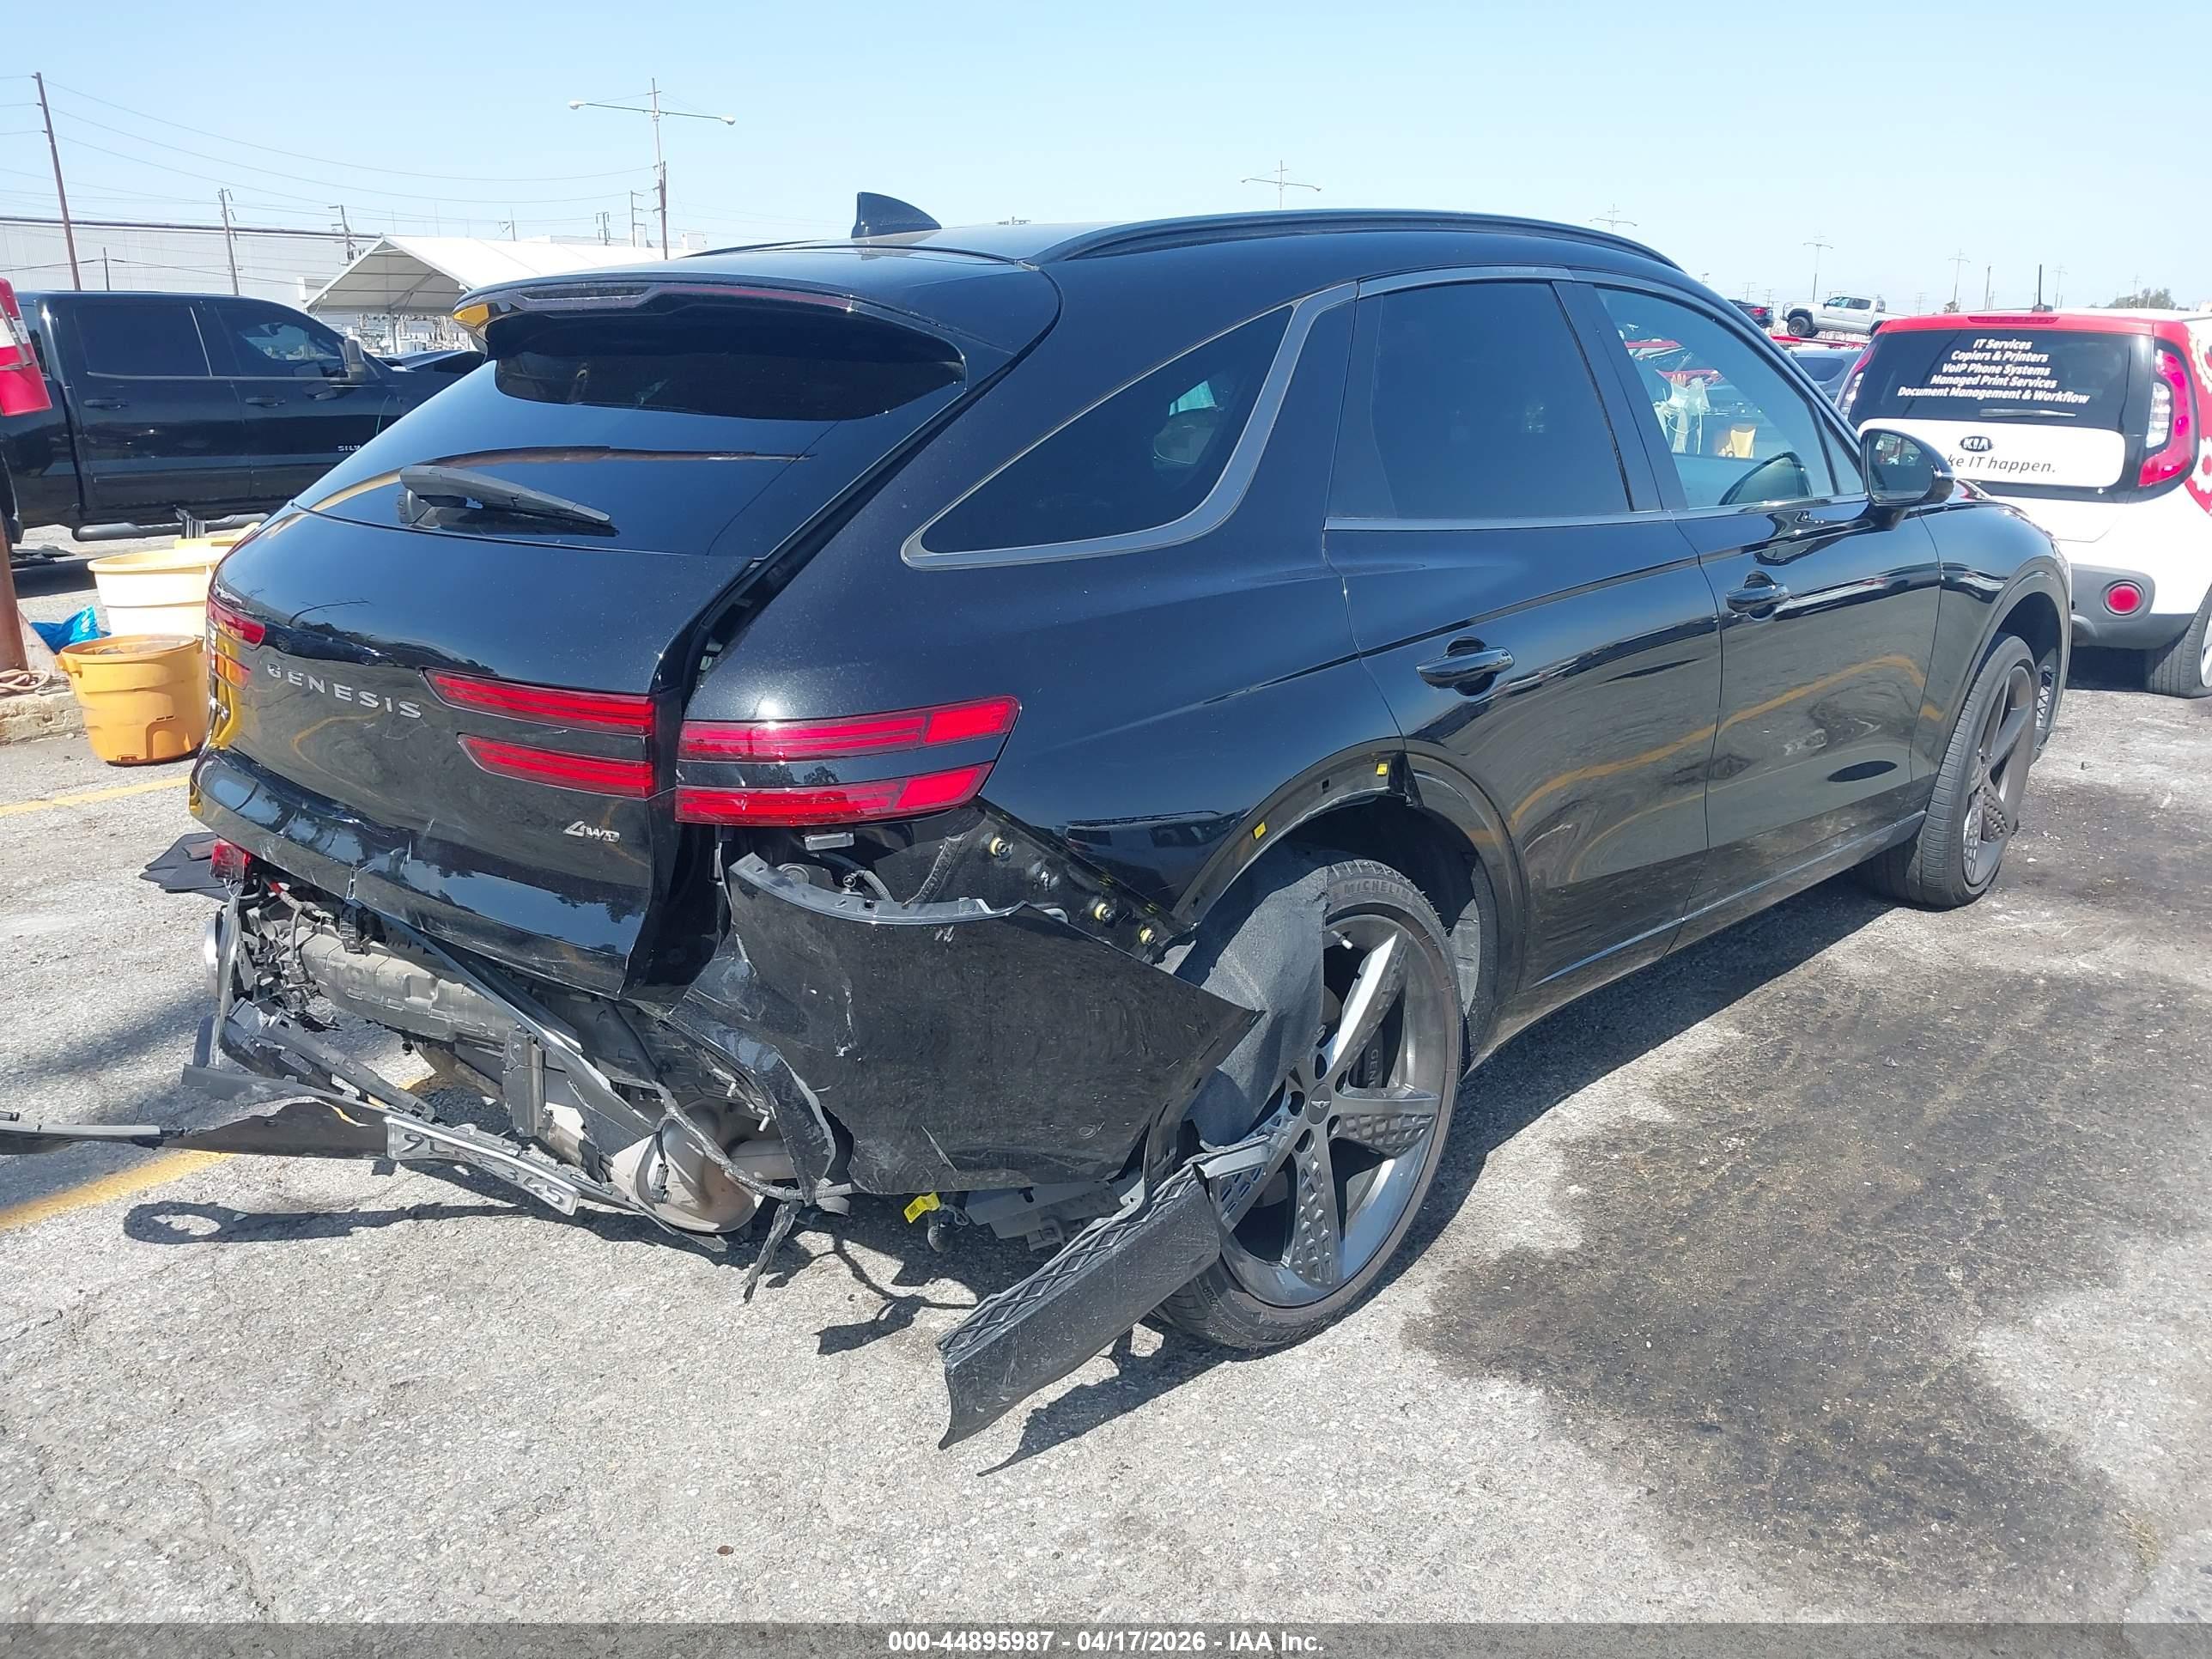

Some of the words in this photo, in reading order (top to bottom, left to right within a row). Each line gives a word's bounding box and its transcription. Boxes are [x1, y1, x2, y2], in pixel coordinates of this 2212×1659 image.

[1973, 339, 1987, 349] IT
[1985, 339, 2033, 350] Services
[1951, 350, 1990, 362] Copiers
[1991, 351, 2002, 362] &
[2002, 351, 2049, 362] Printers
[1942, 363, 1967, 373] VoIP
[1967, 363, 2002, 374] Phone
[2003, 364, 2051, 377] Systems
[1930, 375, 1980, 387] Managed
[1980, 375, 2010, 386] Print
[2011, 377, 2057, 389] Services
[1898, 386, 1949, 397] Document
[1949, 387, 2021, 400] Management
[2021, 390, 2033, 400] &
[2033, 391, 2090, 404] Workflow
[1963, 438, 1989, 450] KIA
[1969, 456, 1985, 468] IT
[1988, 457, 2056, 473] happen.
[267, 663, 422, 720] GENESIS
[562, 820, 620, 842] 4WD
[1344, 880, 1410, 901] MICHELIN
